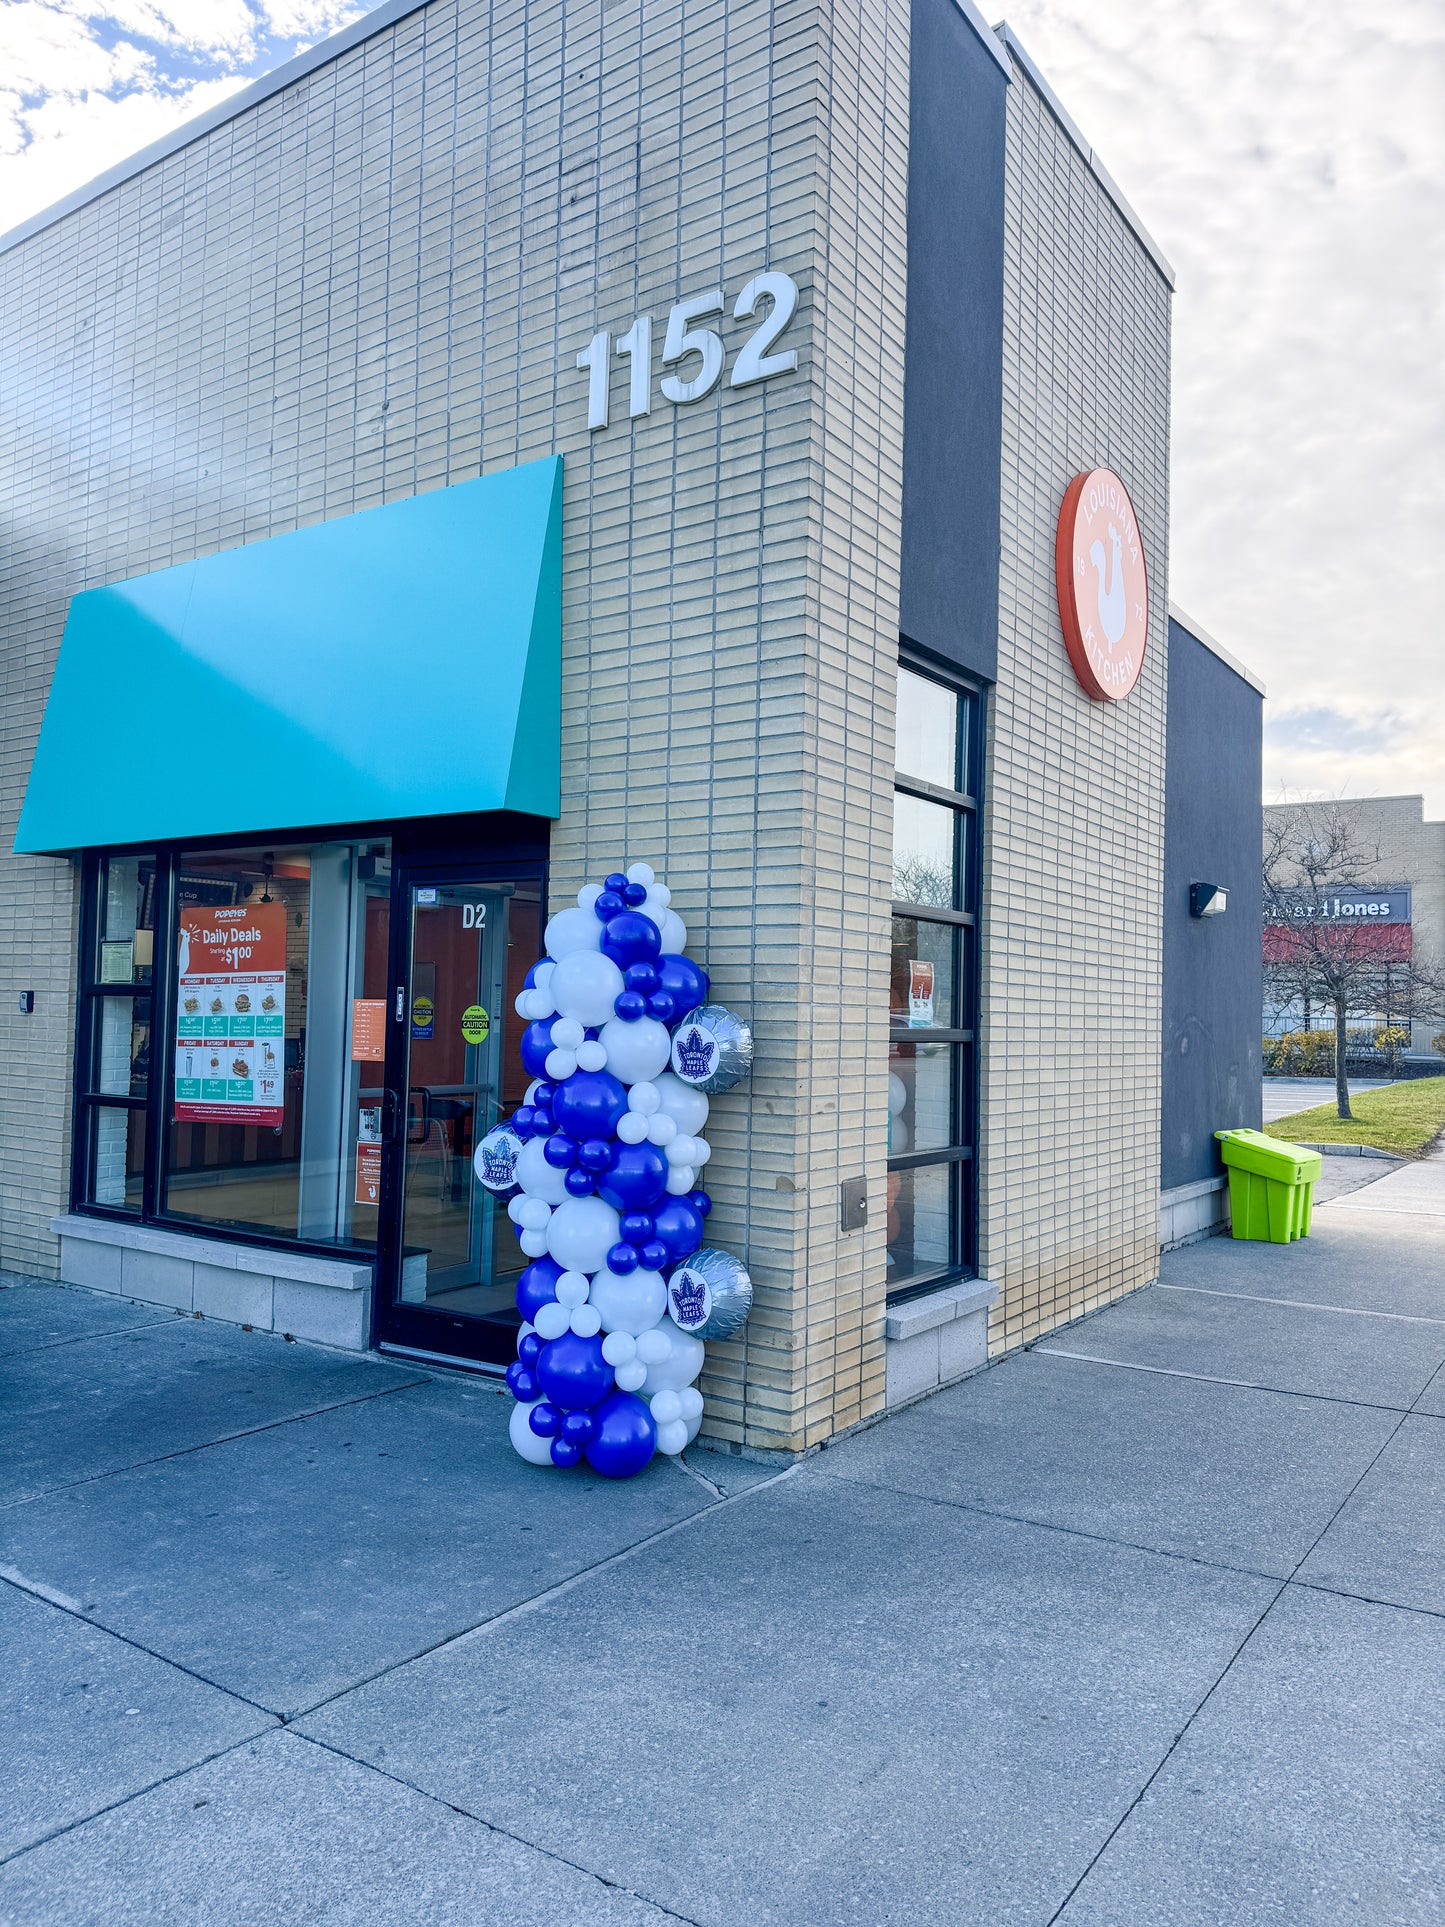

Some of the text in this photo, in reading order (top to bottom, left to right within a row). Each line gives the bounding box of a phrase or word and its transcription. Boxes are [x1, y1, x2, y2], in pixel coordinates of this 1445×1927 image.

[577, 271, 799, 432] 1152
[1083, 482, 1138, 565] LOUISIANA
[1076, 556, 1085, 577] 19
[1135, 603, 1143, 622] 72
[1084, 624, 1133, 686] KITCHEN
[462, 903, 486, 929] D2
[1331, 899, 1390, 920] Jones
[203, 927, 261, 946] Daily Deals
[209, 947, 225, 955] Starting
[683, 1051, 708, 1061] TORONTO
[489, 1158, 513, 1168] TORONTO
[679, 1296, 702, 1306] TORONTO
